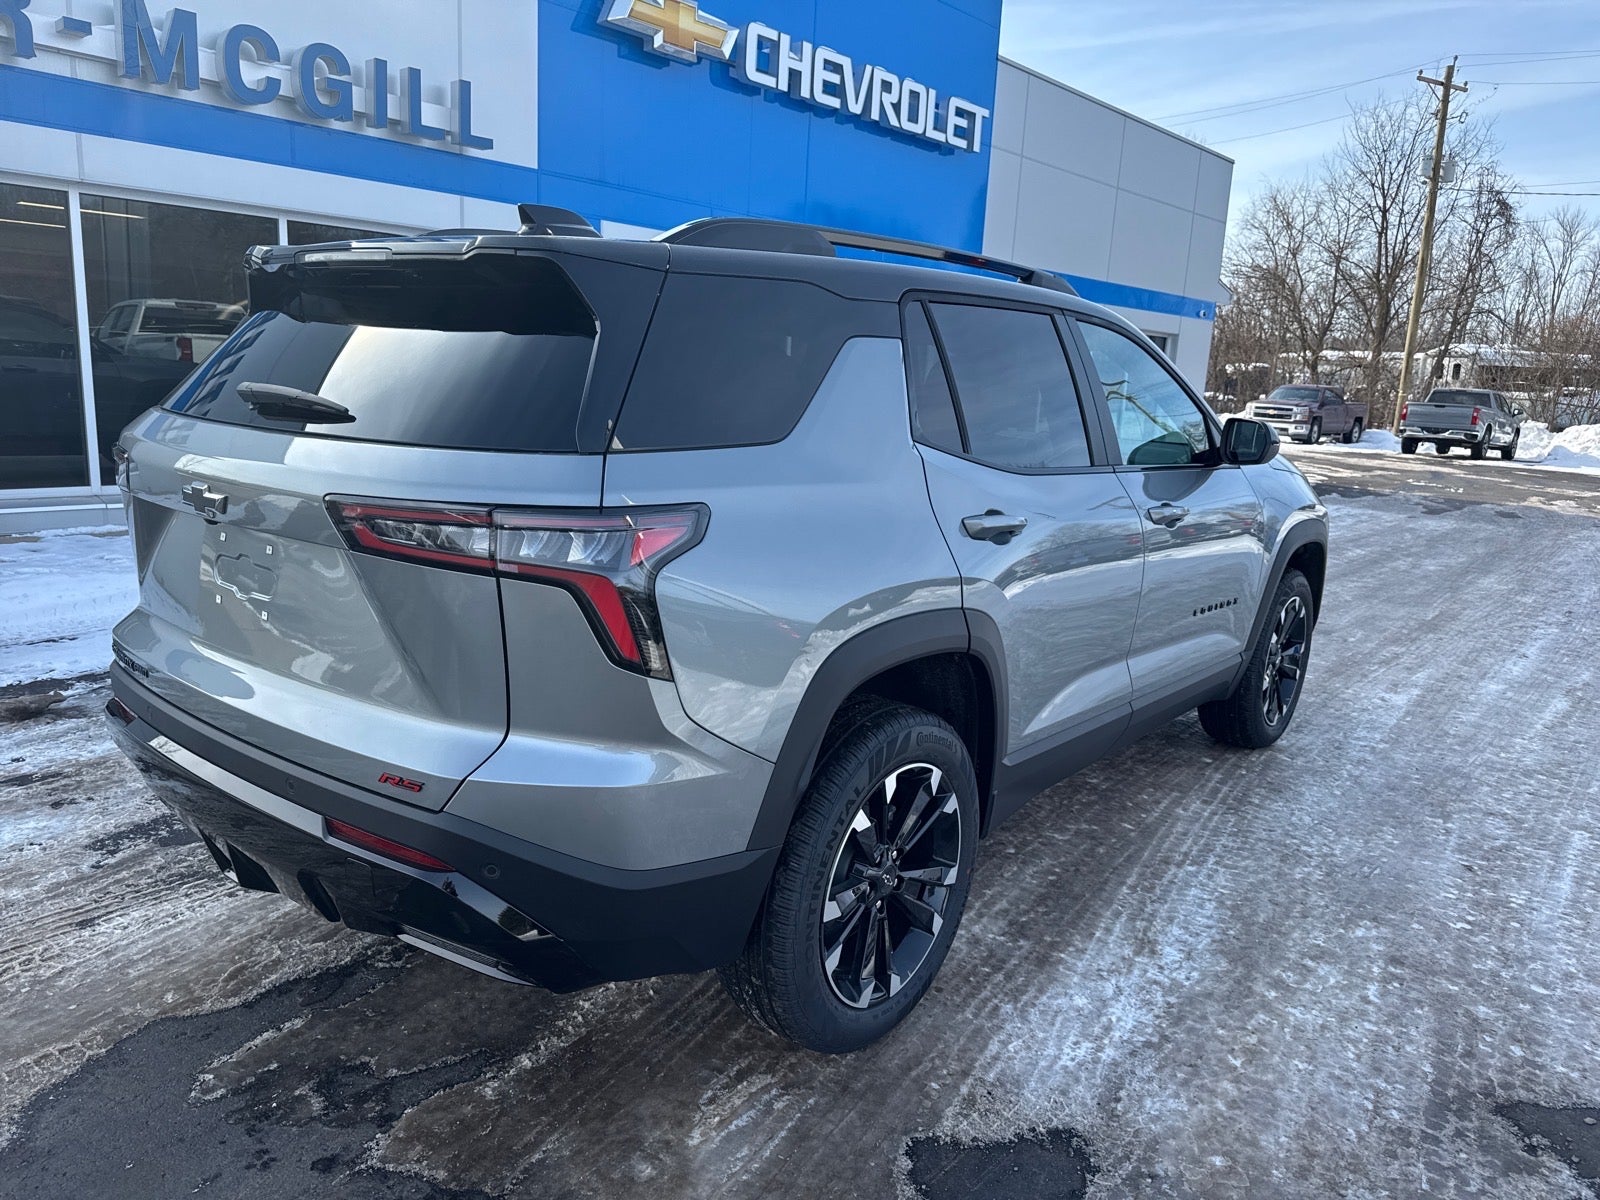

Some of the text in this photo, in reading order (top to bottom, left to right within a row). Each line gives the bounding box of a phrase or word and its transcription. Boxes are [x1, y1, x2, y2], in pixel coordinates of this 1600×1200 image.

[744, 21, 990, 153] CHEVROLET
[916, 731, 954, 747] Continental
[378, 771, 425, 792] RS
